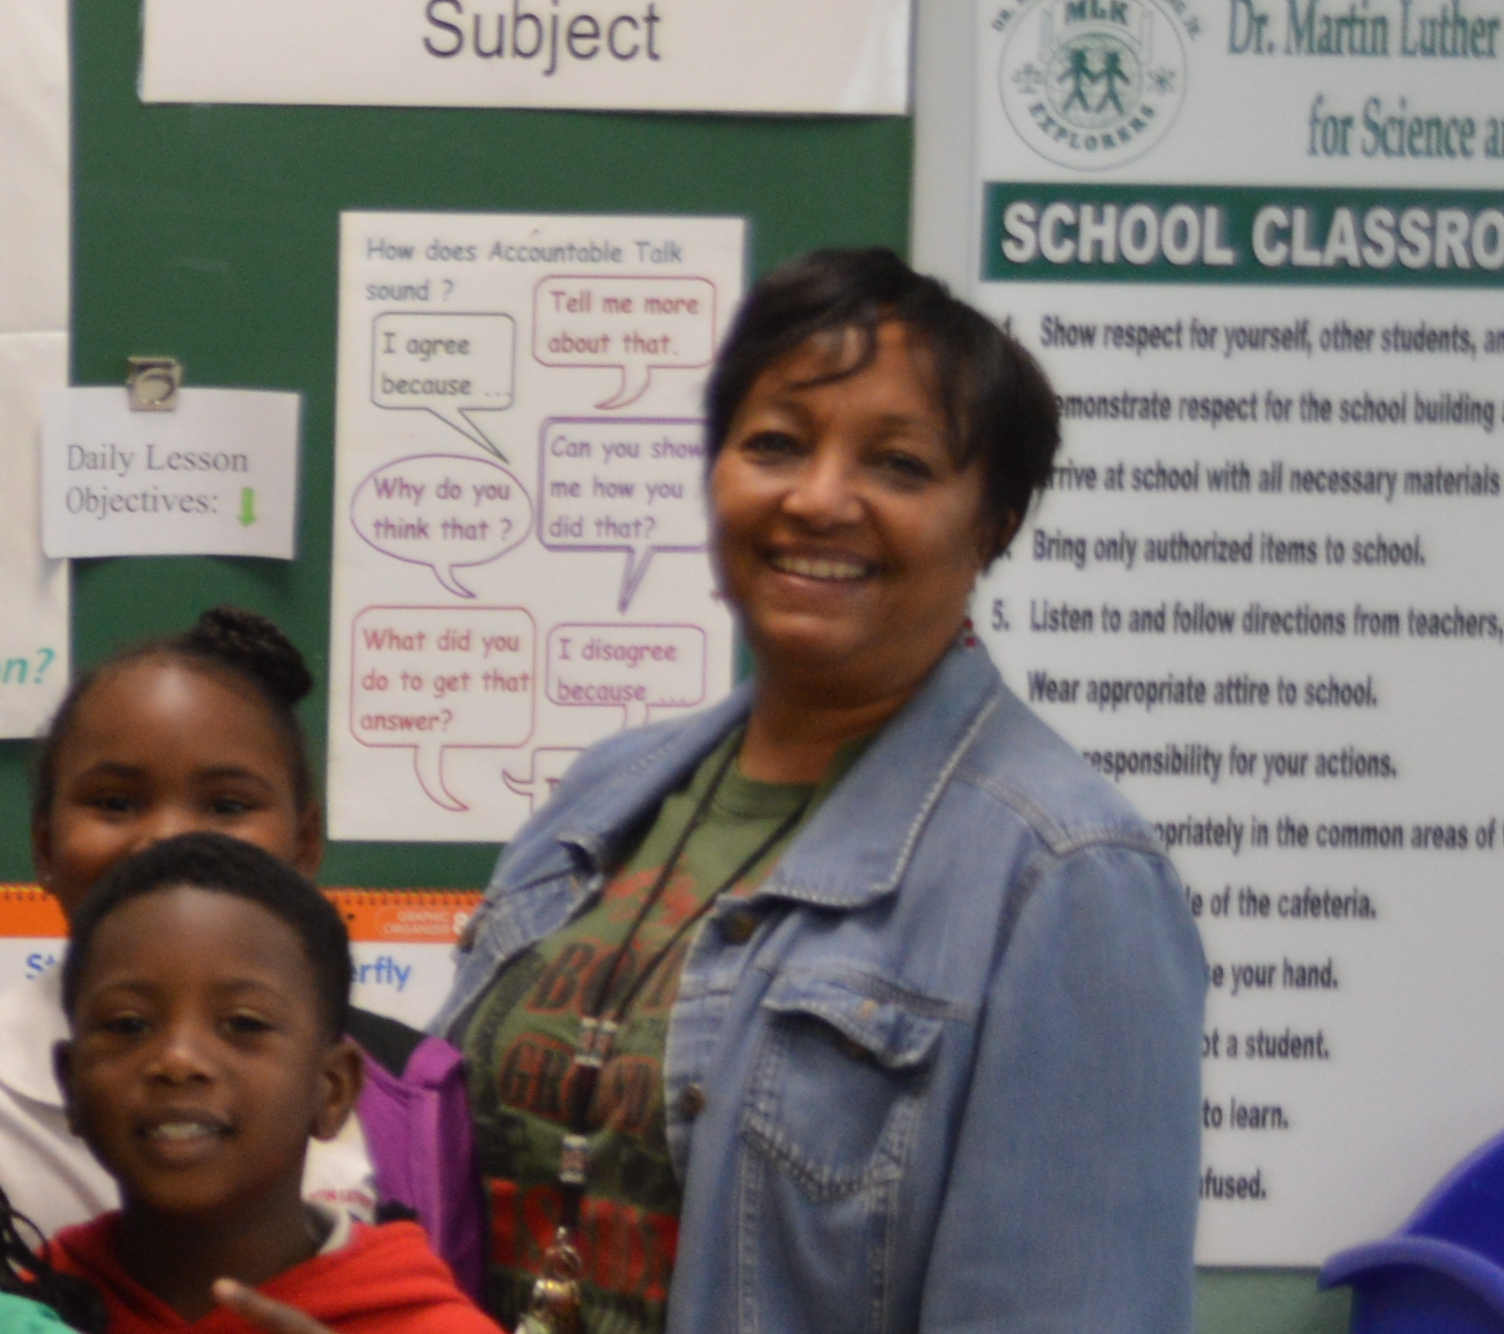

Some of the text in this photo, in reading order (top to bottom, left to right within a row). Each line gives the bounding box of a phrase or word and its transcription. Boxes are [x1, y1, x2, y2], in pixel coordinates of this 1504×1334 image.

[1309, 94, 1477, 159] for Science
[1002, 202, 1234, 265] SCHOOL
[367, 239, 682, 263] How does Accountable Talk
[366, 279, 430, 301] sound
[550, 290, 699, 314] Tell more
[406, 339, 470, 362] agree
[548, 331, 679, 354] about that.
[1041, 315, 1476, 359] Show respect yourself, other students,
[382, 373, 472, 396] because
[1179, 393, 1496, 432] respect school building
[68, 444, 250, 478] Daily Lesson
[550, 435, 640, 464] Can you
[374, 477, 510, 506] Why you
[593, 476, 684, 504] how you
[1132, 461, 1501, 501] school with necessary materials
[66, 486, 218, 520] Objectives:
[373, 517, 489, 540] think that
[594, 516, 656, 539] that?
[1033, 528, 1425, 570] Bring only authorized items school.
[1031, 601, 1401, 636] Listen follow directions from
[363, 628, 426, 651] What
[581, 638, 677, 668] disagree
[481, 669, 531, 693] that
[557, 680, 646, 701] because
[1029, 672, 1377, 710] Wear appropriate attire school.
[361, 709, 453, 731] answer?
[1264, 753, 1309, 784] your
[1315, 747, 1397, 778] actions.
[1316, 825, 1469, 849] common areas
[1277, 887, 1376, 919] cafeteria.
[1232, 959, 1338, 995] your hand.
[1246, 1029, 1329, 1059] student.
[1230, 1099, 1289, 1129] learn.
